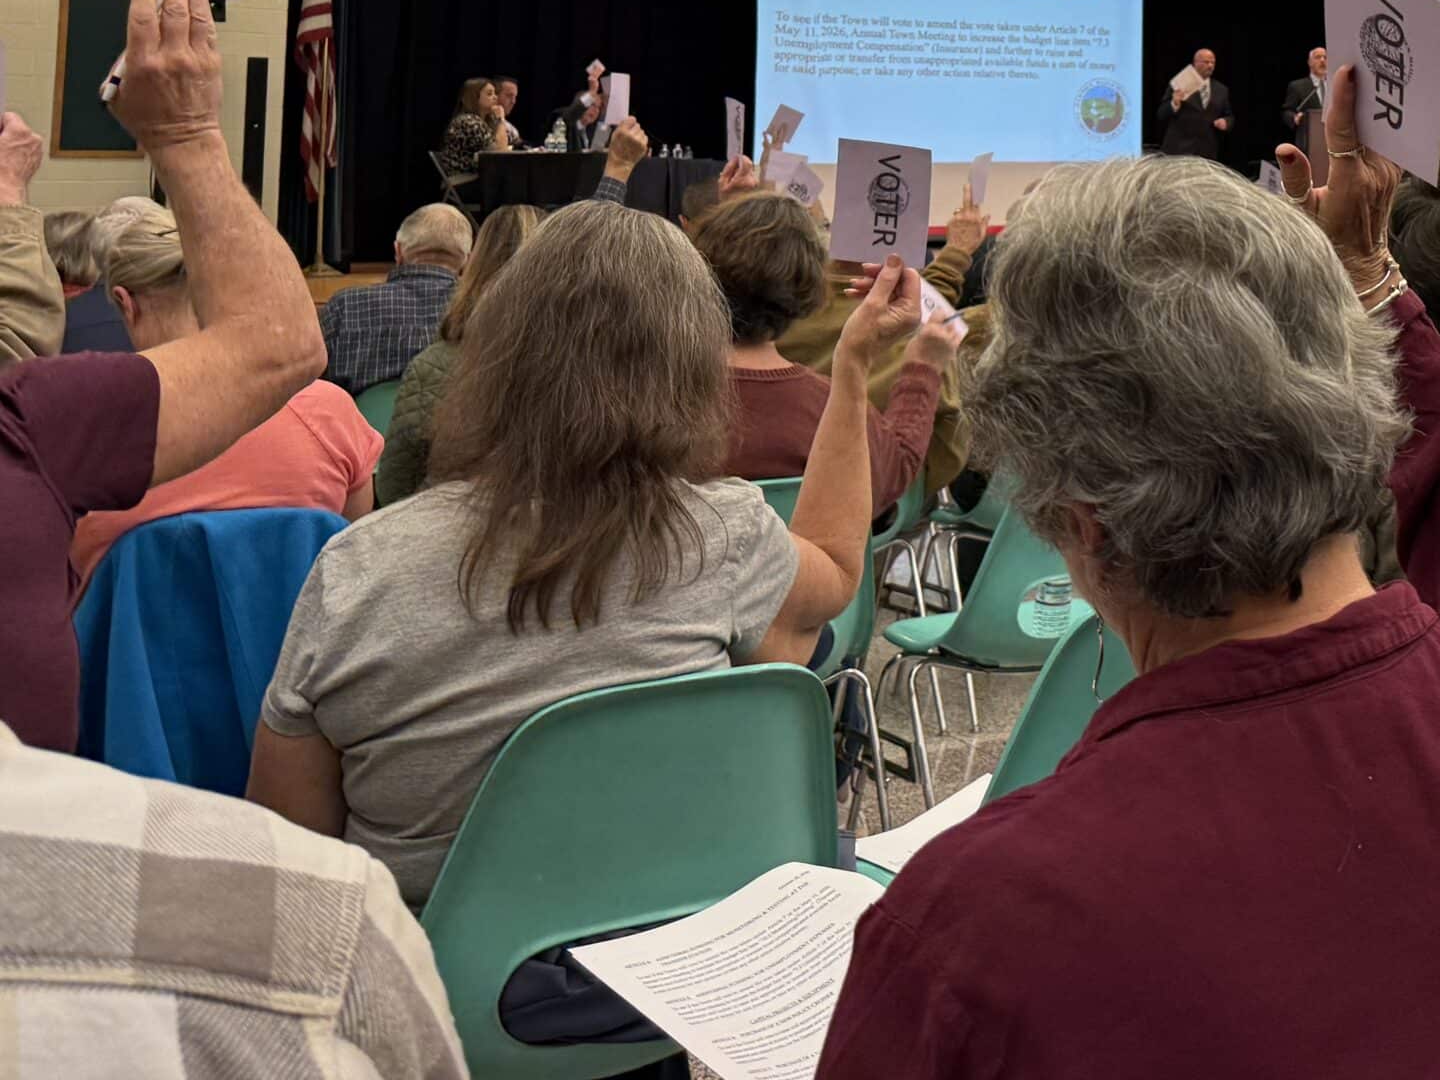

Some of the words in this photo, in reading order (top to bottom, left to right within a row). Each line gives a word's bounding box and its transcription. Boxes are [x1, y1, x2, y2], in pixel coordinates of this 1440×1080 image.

[776, 11, 790, 21] To
[793, 15, 811, 24] see
[813, 14, 821, 24] if
[822, 14, 837, 24] the
[840, 15, 869, 25] Town
[872, 16, 889, 26] will
[892, 17, 912, 27] vote
[915, 18, 924, 27] to
[959, 20, 972, 29] the
[1049, 24, 1077, 34] Article
[775, 24, 800, 37] May
[851, 28, 886, 39] Annual
[889, 29, 914, 40] Town
[917, 30, 956, 42] Meeting
[775, 37, 853, 51] Unemployment
[849, 53, 885, 63] transfer
[888, 54, 911, 64] from
[775, 63, 789, 73] for
[917, 67, 940, 76] other
[872, 155, 901, 246] VOTER
